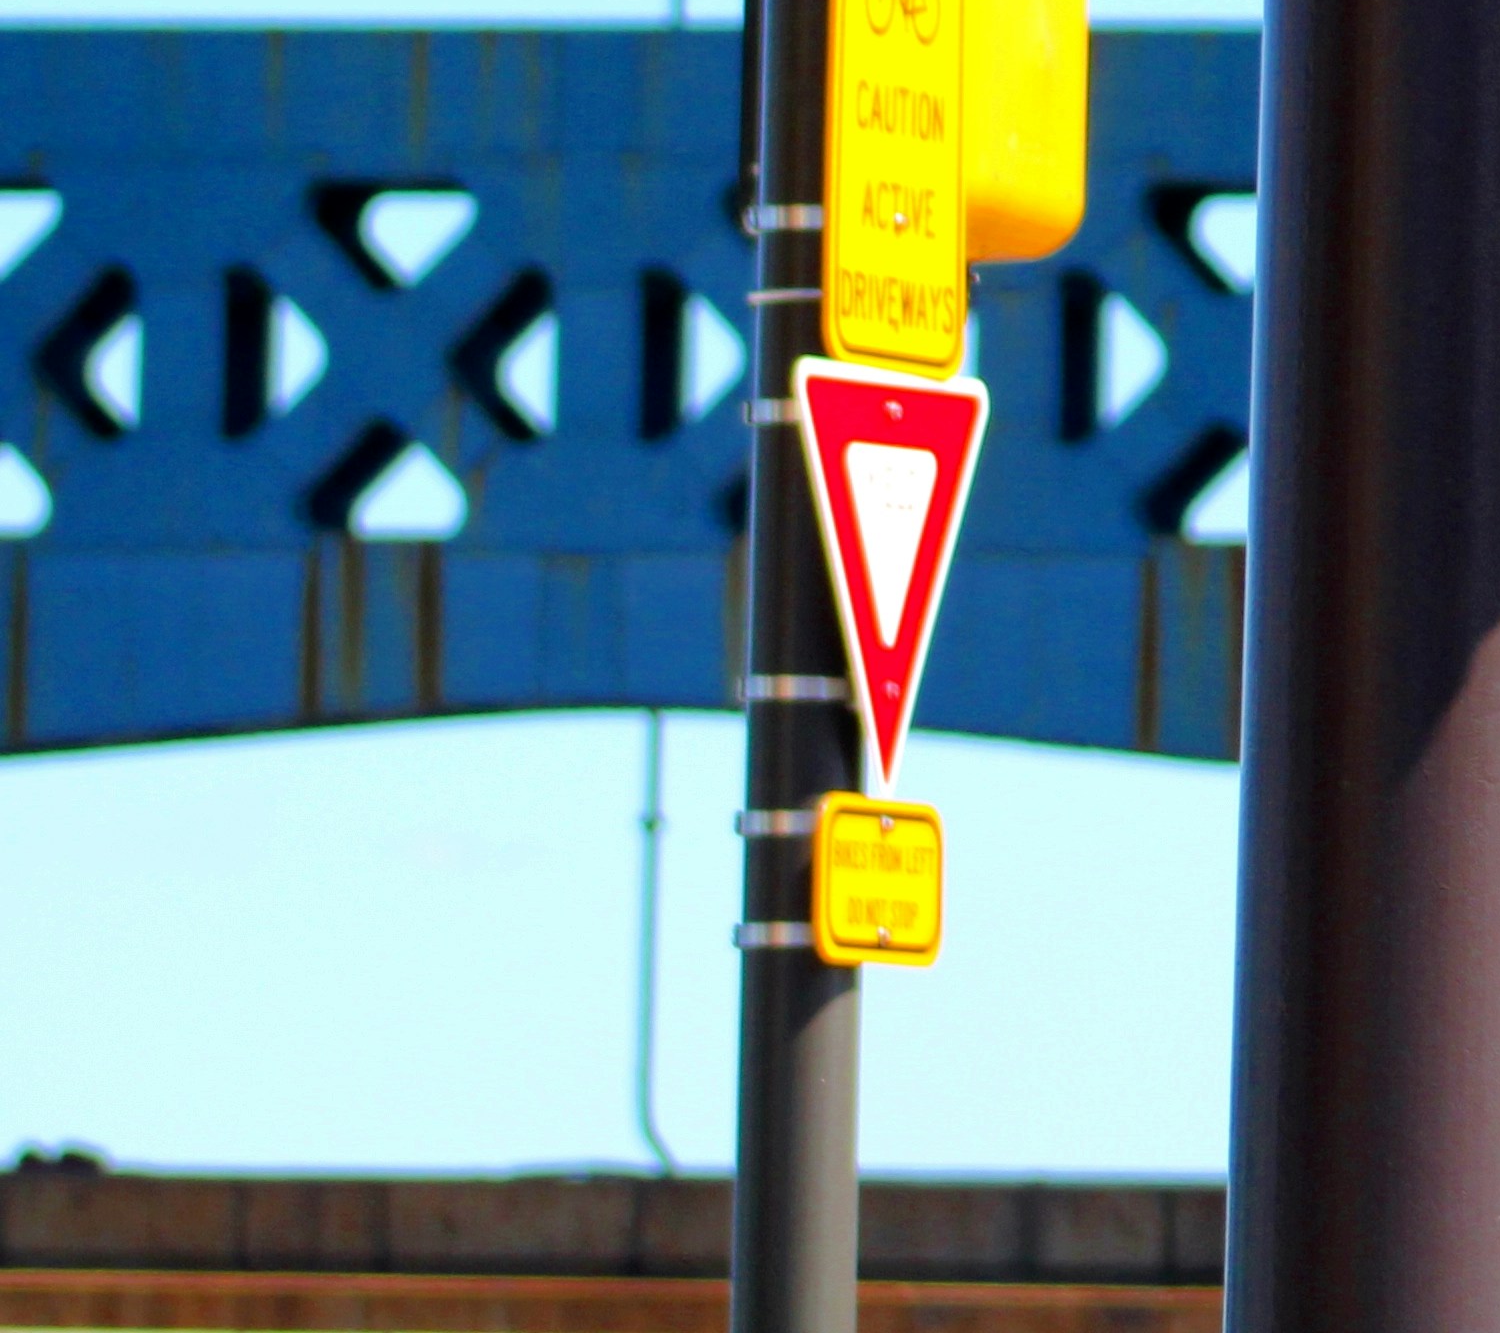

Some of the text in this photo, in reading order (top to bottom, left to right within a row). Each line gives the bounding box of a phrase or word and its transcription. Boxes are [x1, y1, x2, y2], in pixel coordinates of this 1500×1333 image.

[856, 79, 945, 142] CAUTION
[862, 180, 936, 239] ACTIVE
[841, 268, 954, 334] DRIVEWAYS
[905, 845, 936, 876] LEFT
[890, 900, 919, 929] STOP
